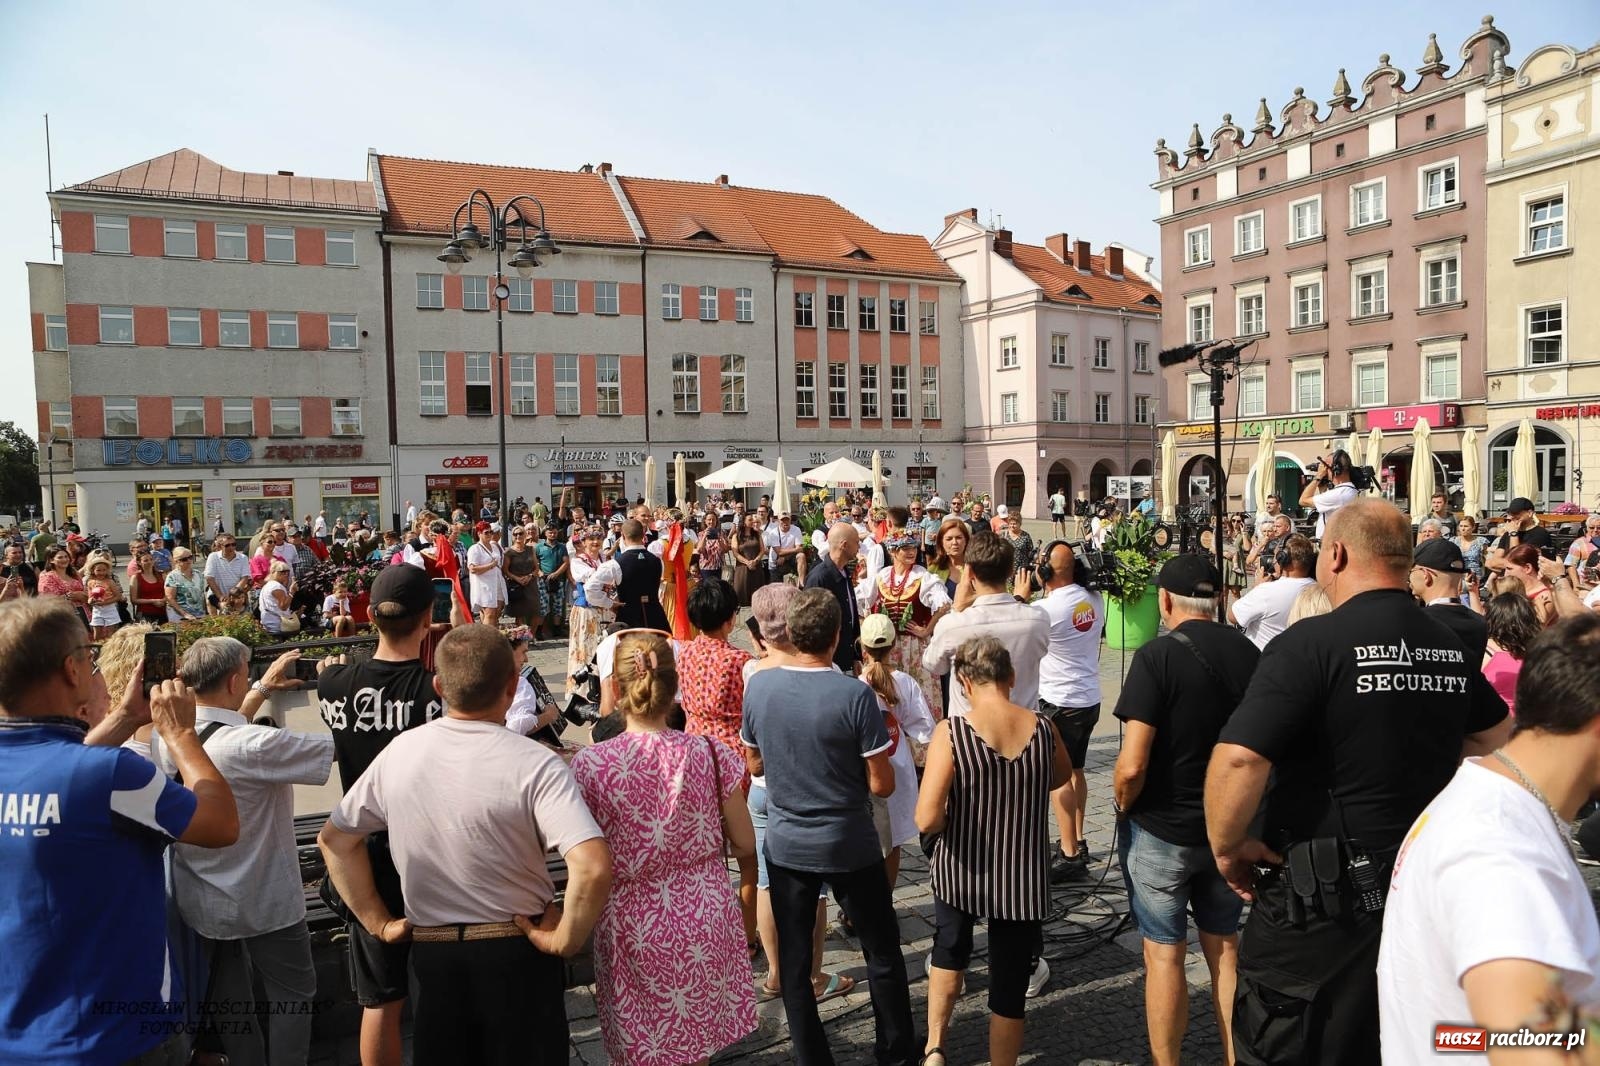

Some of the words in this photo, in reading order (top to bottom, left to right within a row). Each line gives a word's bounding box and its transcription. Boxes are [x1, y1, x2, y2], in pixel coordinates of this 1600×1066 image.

[103, 437, 252, 465] BOLKO
[543, 449, 609, 461] JUBILER
[1356, 674, 1467, 693] SECURITY
[0, 793, 61, 825] AHA
